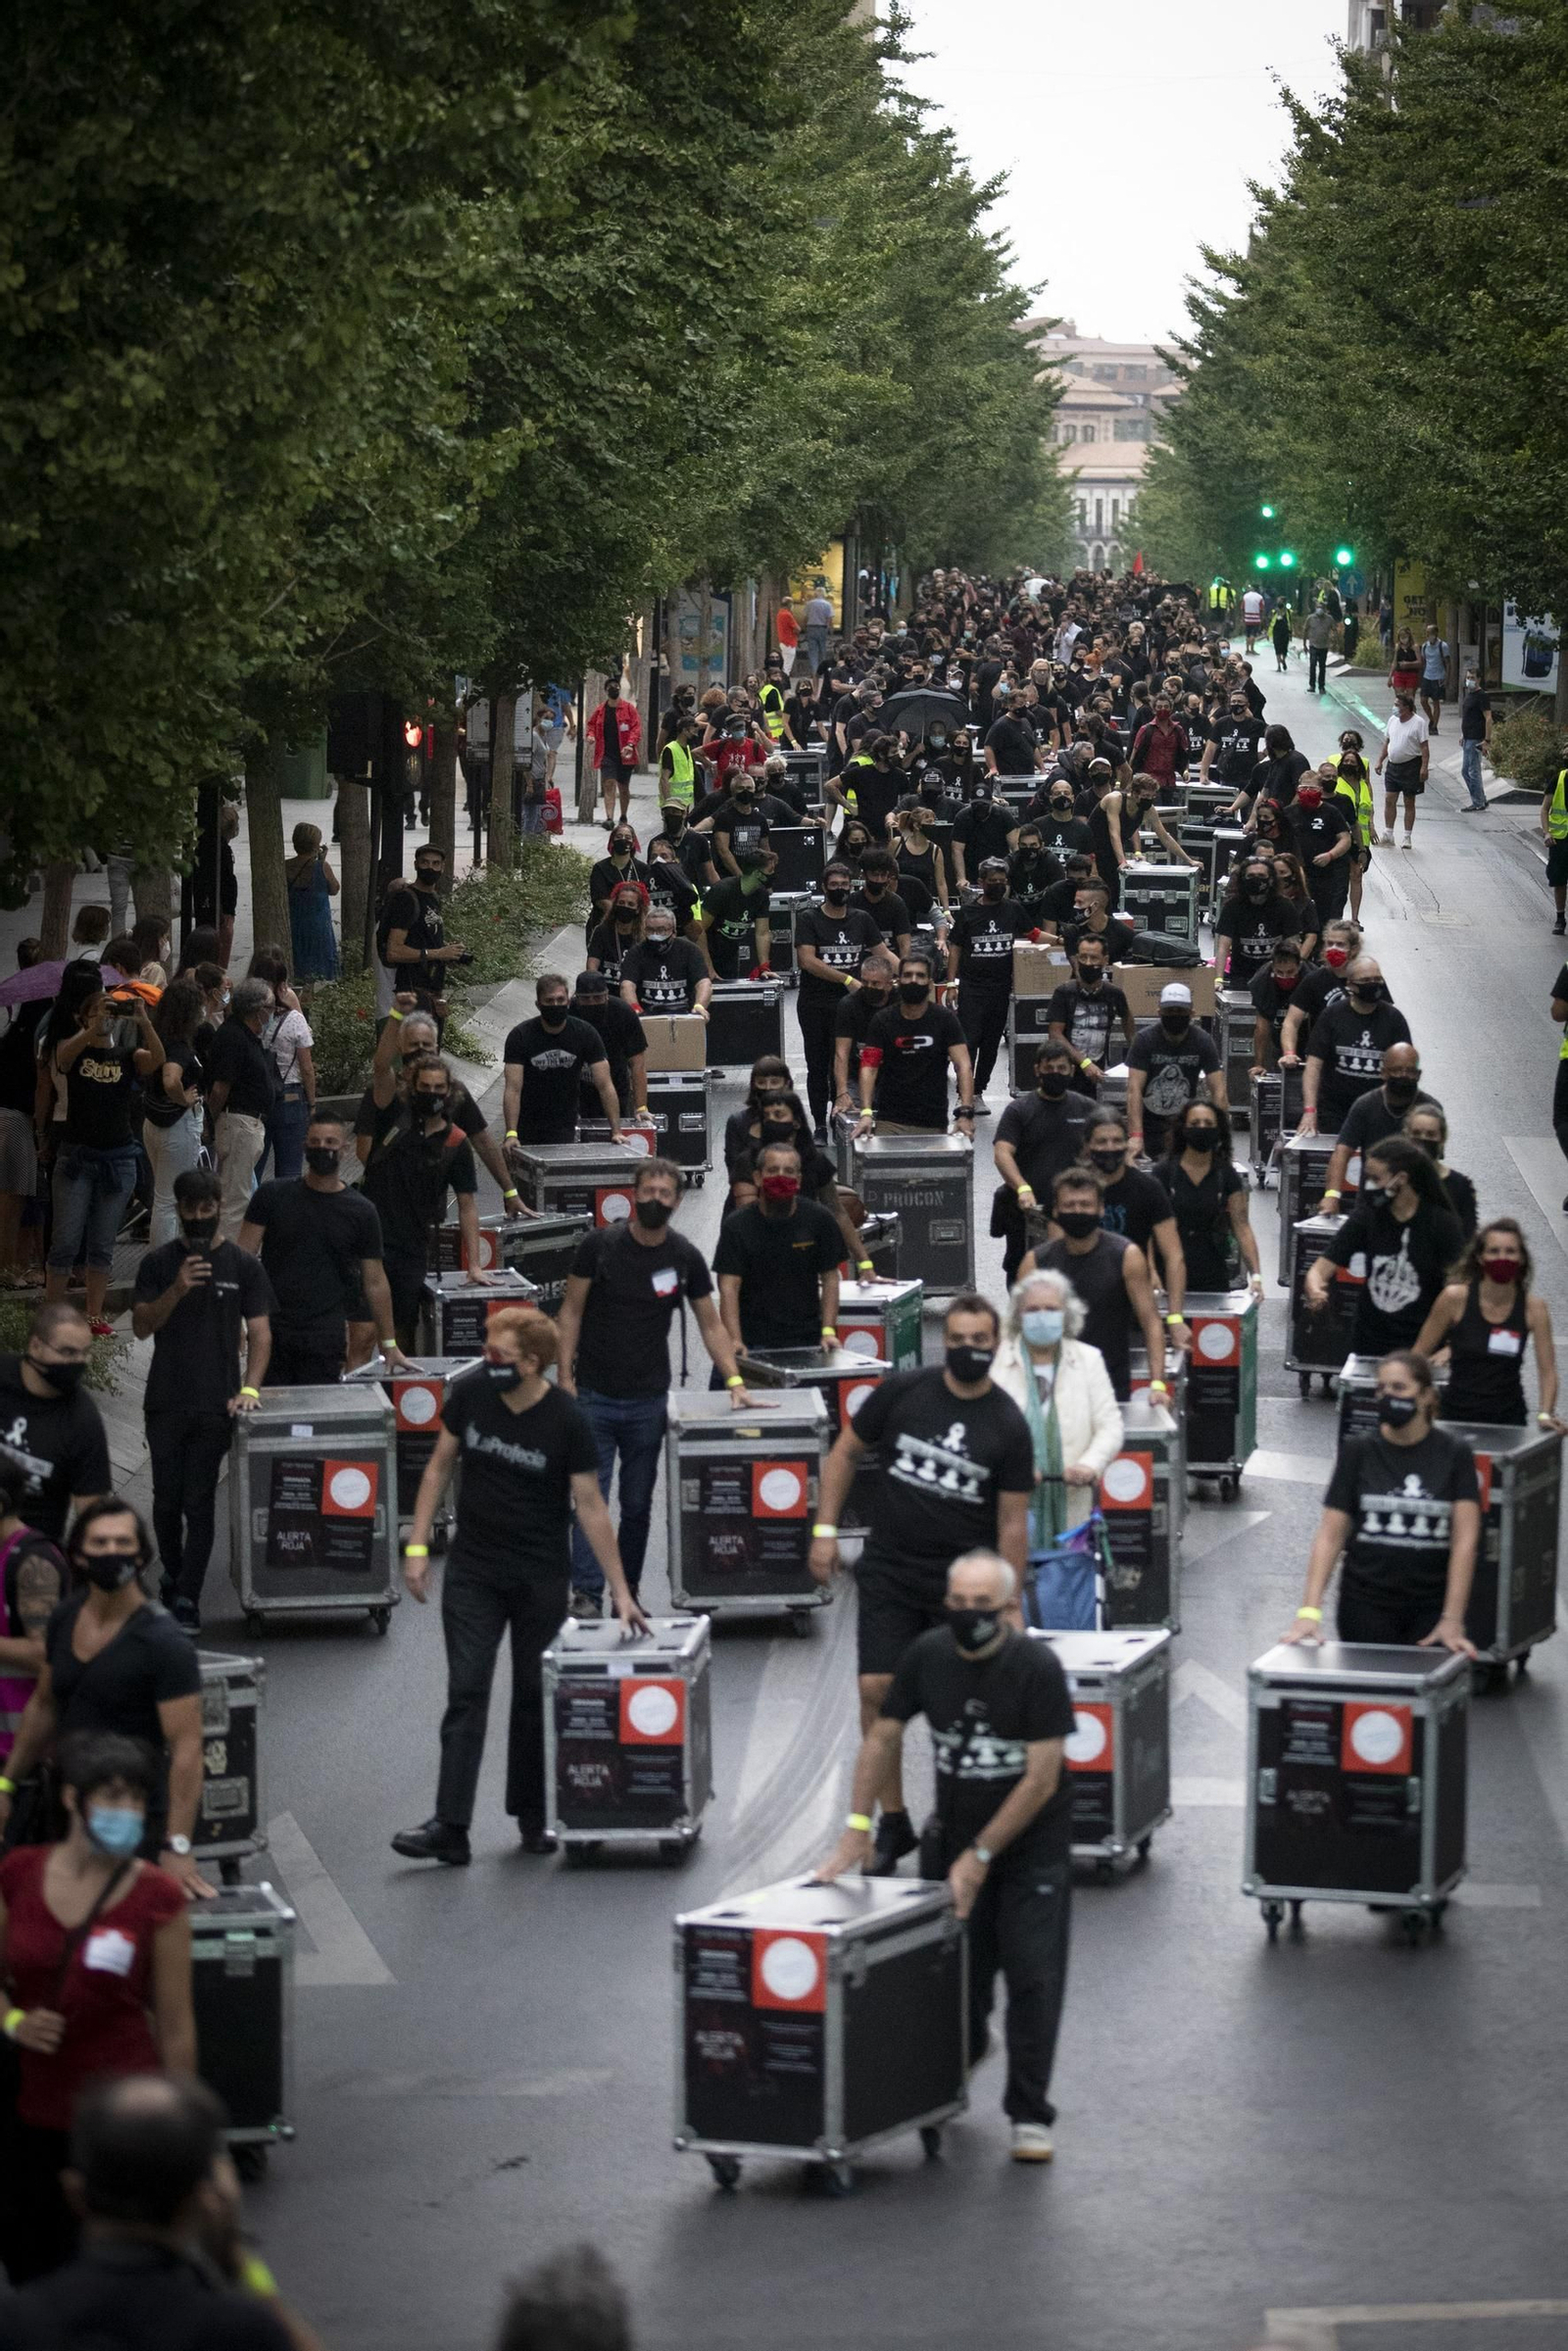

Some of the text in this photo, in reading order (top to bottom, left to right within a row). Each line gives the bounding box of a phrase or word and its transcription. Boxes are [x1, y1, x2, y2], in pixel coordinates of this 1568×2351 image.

[883, 1191, 945, 1206] PROCON
[276, 1530, 313, 1543] ALERTA
[708, 1535, 745, 1545] ALERTA
[280, 1541, 306, 1551] ROJA
